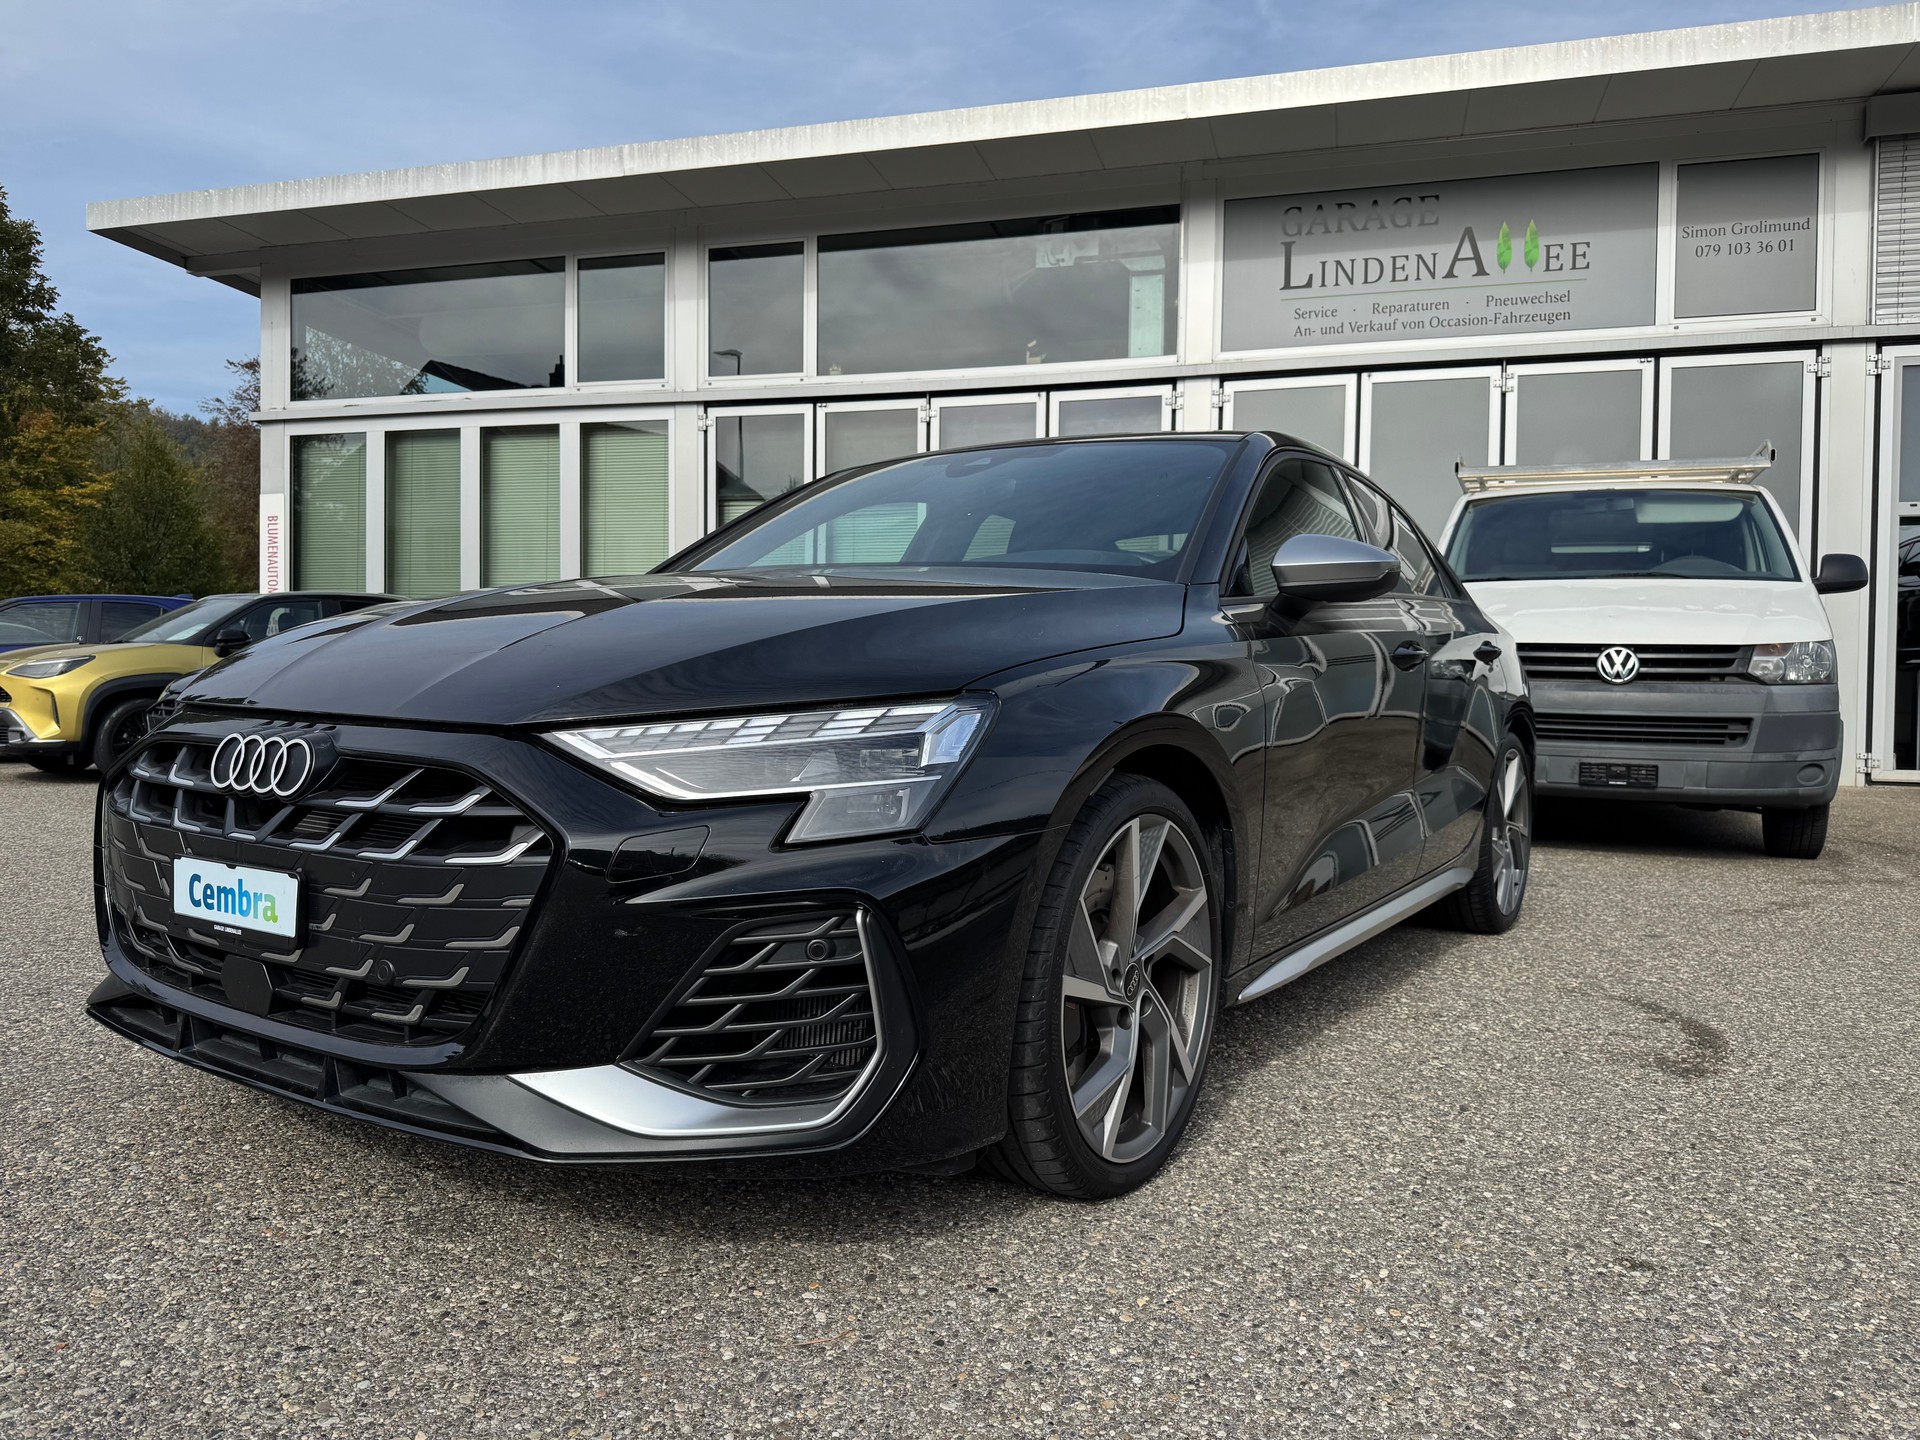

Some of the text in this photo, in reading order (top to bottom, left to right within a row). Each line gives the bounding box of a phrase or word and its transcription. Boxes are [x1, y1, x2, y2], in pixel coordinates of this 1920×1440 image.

[1281, 194, 1440, 237] GARAGE
[1682, 217, 1811, 239] Simon Grolimund
[1695, 238, 1795, 258] 079 103 36 01
[1293, 290, 1571, 320] Service Reparaturen Pneuwechsel
[1293, 310, 1571, 337] An- und Verkauf von Occasion-Fahrzeugen
[188, 873, 279, 924] Cembra
